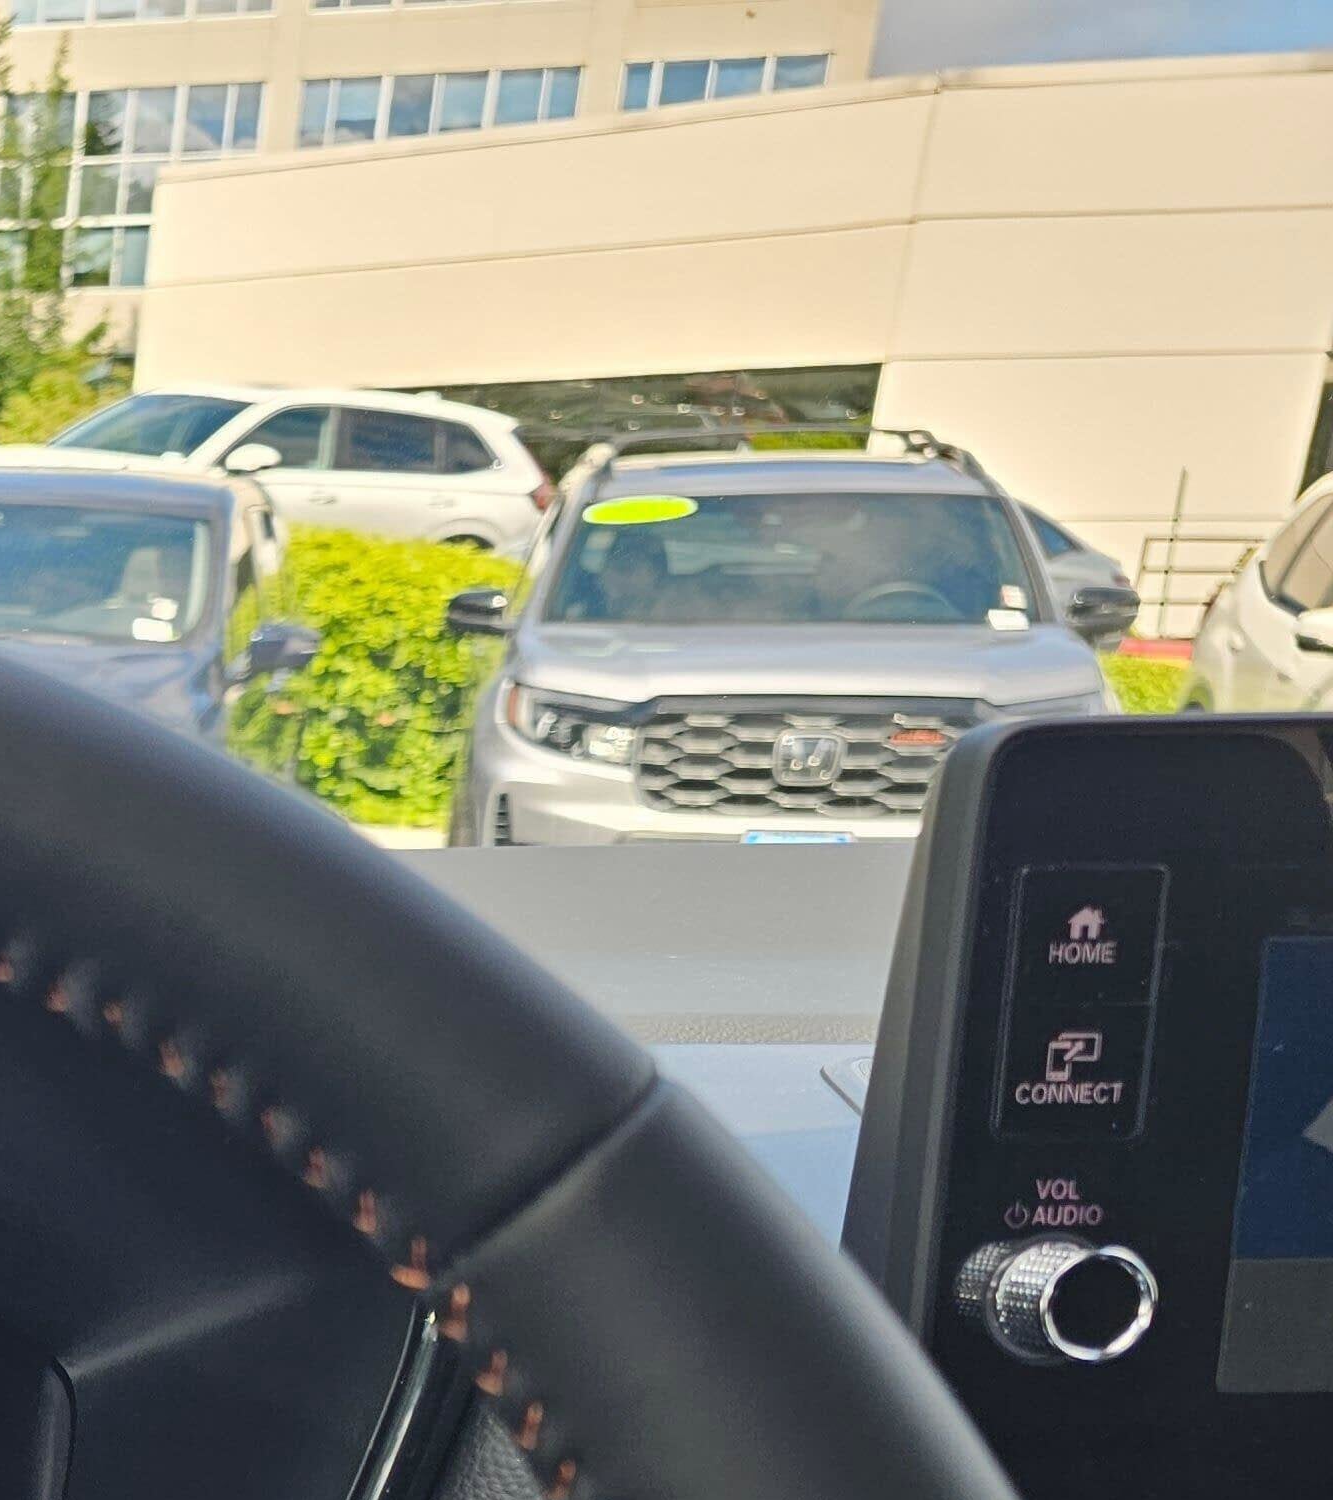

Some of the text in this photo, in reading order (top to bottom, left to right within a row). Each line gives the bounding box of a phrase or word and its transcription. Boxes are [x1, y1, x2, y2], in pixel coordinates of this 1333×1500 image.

[1048, 942, 1118, 965] HOME
[1015, 1081, 1124, 1105] CONNECT
[1036, 1178, 1081, 1201] VOL
[1032, 1205, 1104, 1226] AUDIO
